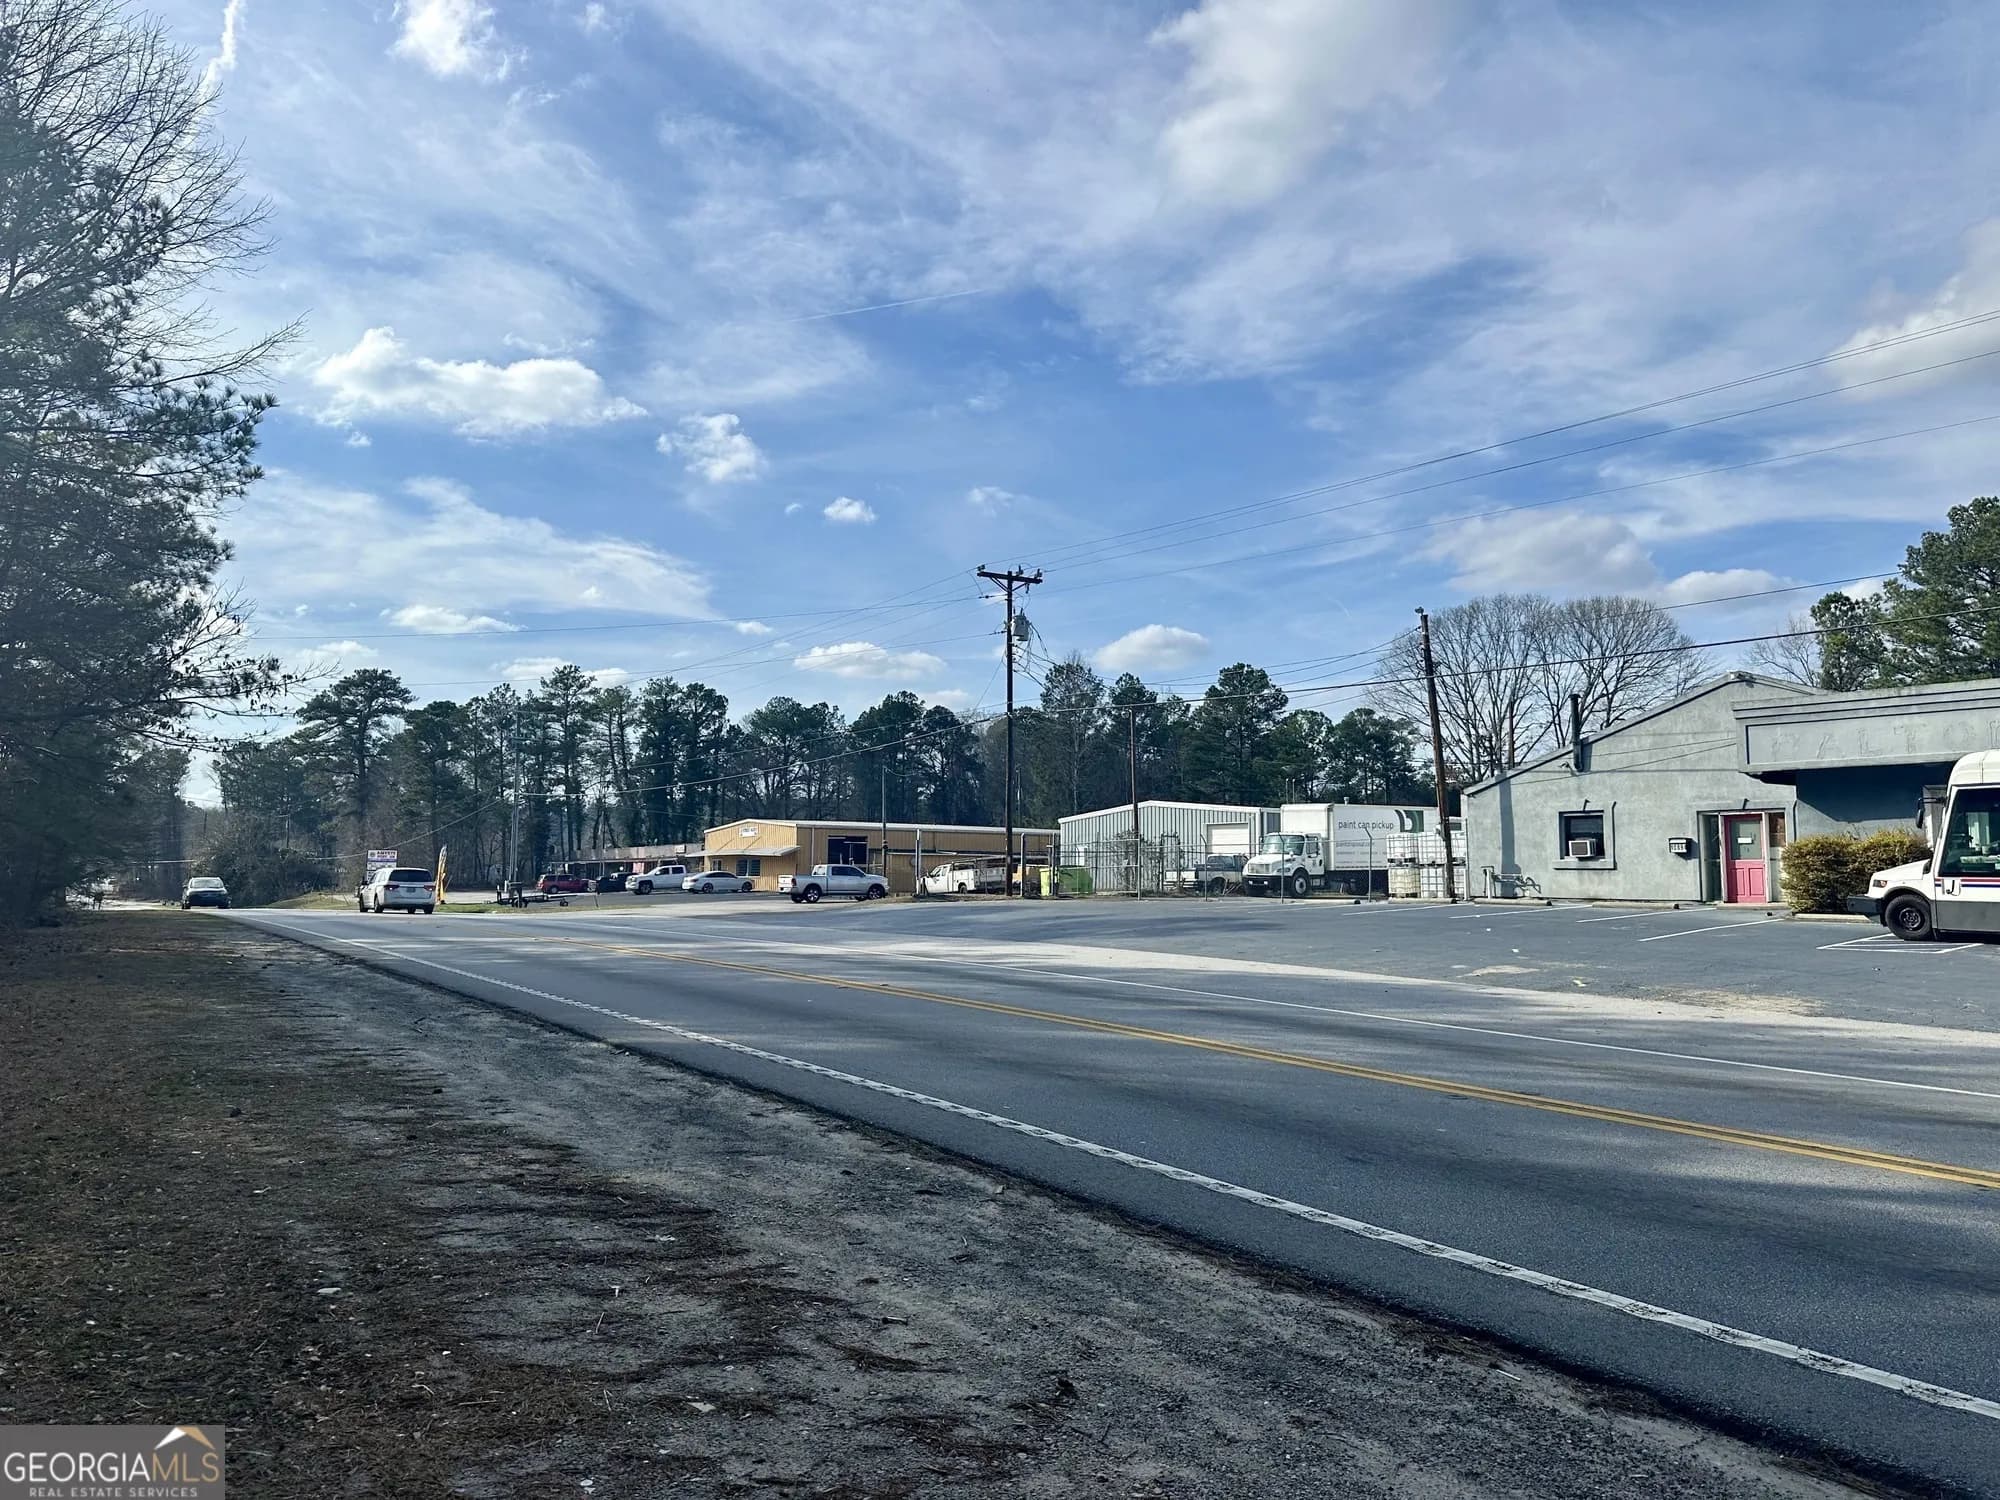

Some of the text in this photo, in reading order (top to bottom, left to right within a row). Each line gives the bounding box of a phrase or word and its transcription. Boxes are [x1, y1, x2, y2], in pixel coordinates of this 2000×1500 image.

[1338, 820, 1394, 831] paint can pickup
